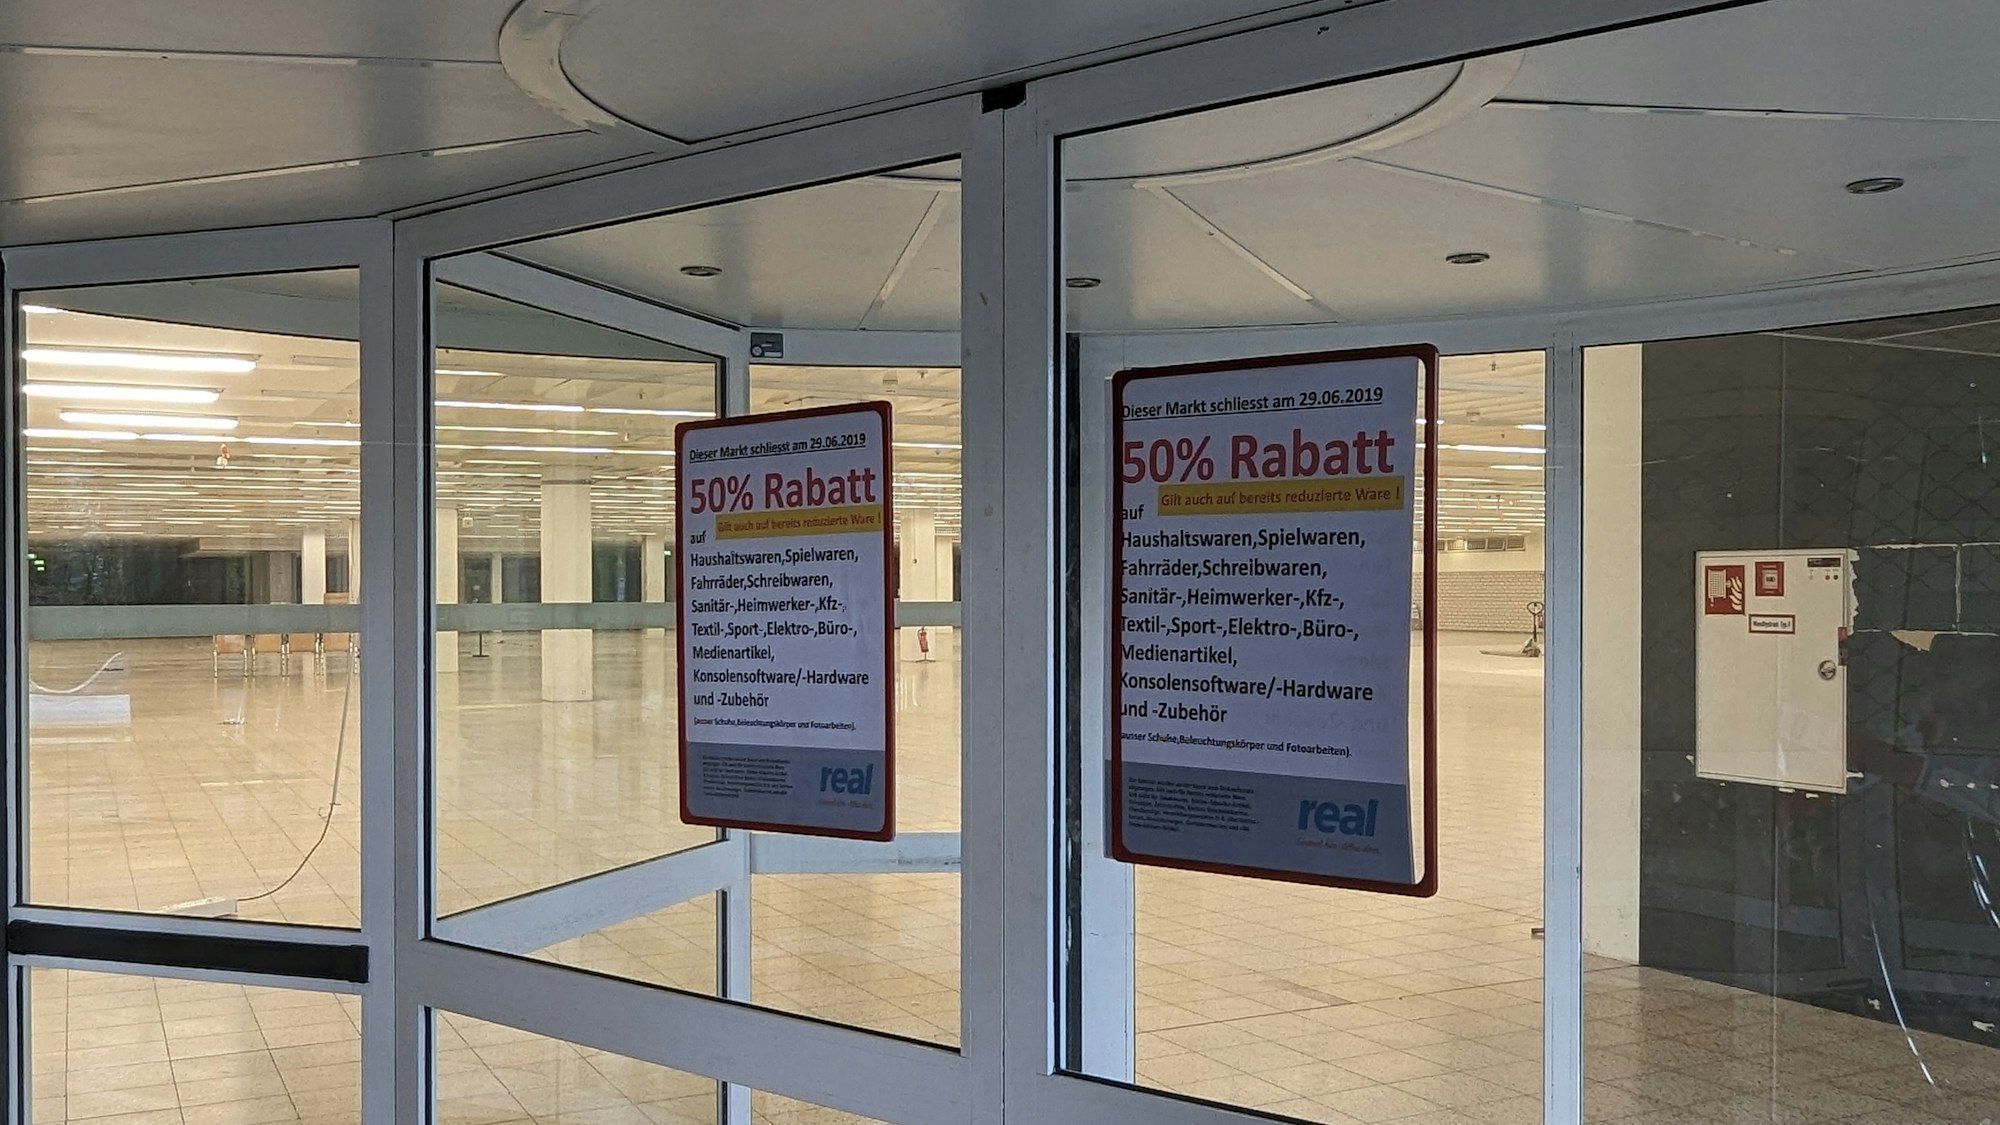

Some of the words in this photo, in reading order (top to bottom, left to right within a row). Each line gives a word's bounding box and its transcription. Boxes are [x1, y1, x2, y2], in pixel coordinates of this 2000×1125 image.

[1122, 404, 1162, 418] Dieser
[1166, 400, 1206, 415] Markt
[1210, 396, 1269, 413] schliesst
[1273, 396, 1295, 409] am
[1299, 387, 1383, 406] 29.06.2019
[689, 446, 717, 461] Dieser
[720, 444, 748, 458] Markt
[750, 441, 790, 455] schliesst
[792, 441, 808, 452] am
[810, 433, 866, 449] 29.06.2019
[1122, 435, 1214, 484] 50%
[1231, 428, 1395, 480] Rabatt
[690, 474, 754, 515] 50%
[765, 467, 876, 509] Rabatt
[1161, 494, 1182, 507] Gilt
[1185, 492, 1213, 506] auch
[1216, 491, 1237, 505] auf
[1239, 491, 1281, 505] bereits
[1285, 488, 1351, 503] reduzierte
[1355, 487, 1391, 500] Ware
[772, 518, 800, 529] bereits
[803, 516, 848, 528] reduzierte
[851, 514, 875, 525] Ware
[1121, 504, 1144, 520] auf
[690, 530, 707, 545] auf
[690, 547, 859, 567] Haushaltswaren,Spielwaren,
[690, 573, 833, 590] Fahrräder,Schreibwaren,
[692, 645, 775, 661] Medienartikel,
[1121, 644, 1237, 668] Medienartikel,
[693, 667, 870, 687] Konsolensoftware/-Hardware
[693, 691, 714, 706] und
[717, 692, 770, 708] -Zubehör
[1121, 700, 1147, 717] und
[1152, 702, 1228, 723] -Zubehör
[1121, 732, 1146, 742] ausser
[1267, 741, 1284, 752] und
[819, 763, 874, 796] real
[1298, 798, 1379, 837] real
